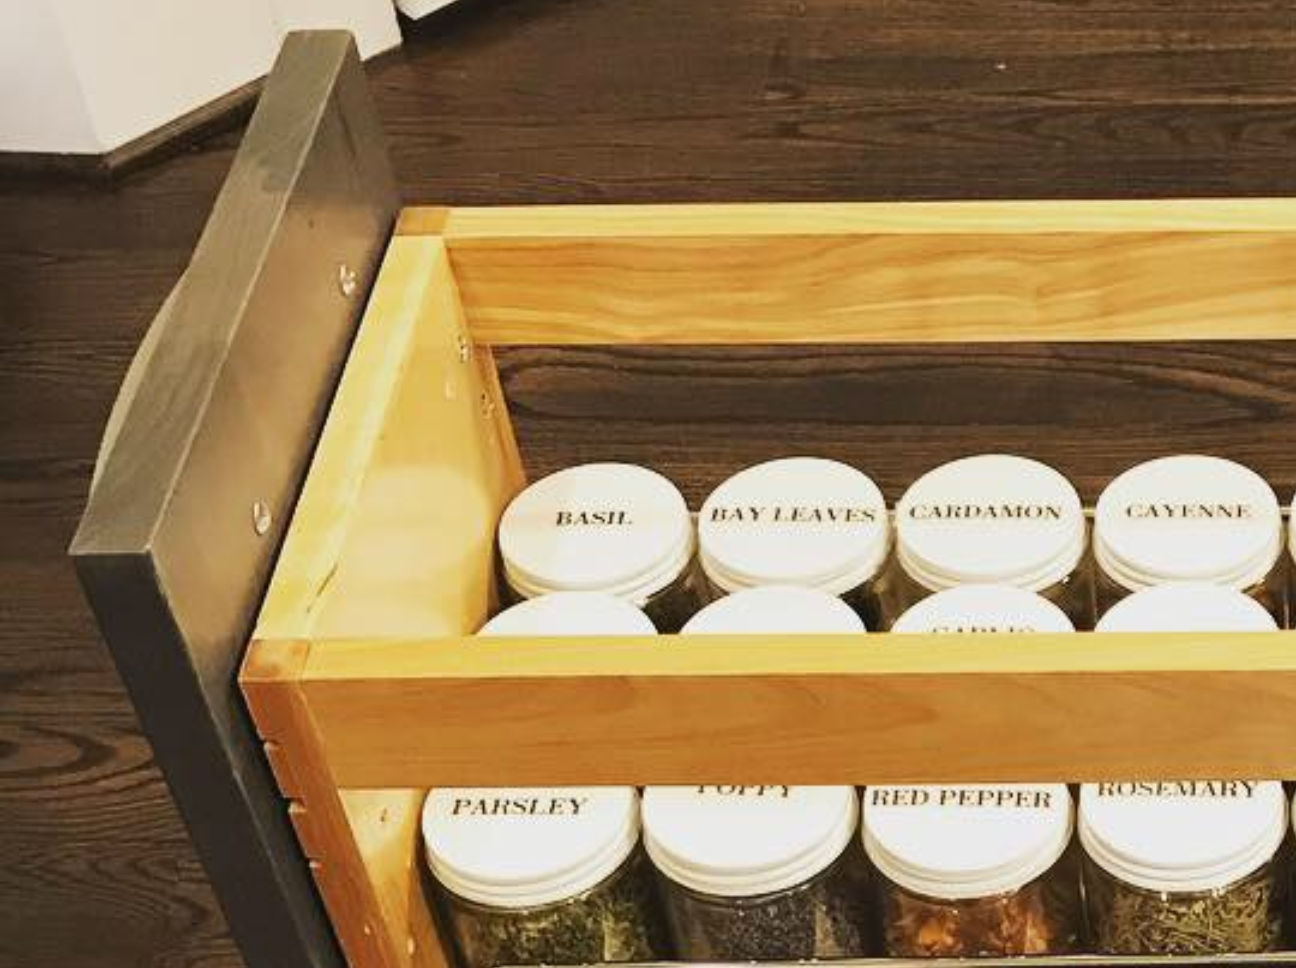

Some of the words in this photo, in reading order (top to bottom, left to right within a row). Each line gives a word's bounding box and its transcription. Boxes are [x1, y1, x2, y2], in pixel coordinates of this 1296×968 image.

[556, 510, 633, 526] BASIL
[710, 506, 766, 522] BAY
[774, 505, 876, 523] LEAVES
[909, 504, 1062, 521] CARDAMON
[1126, 502, 1254, 519] CAYENNE
[1098, 781, 1257, 798] ROSEMARY
[452, 797, 588, 816] PARSLEY
[872, 789, 929, 806] RED
[939, 789, 1053, 808] PEPPER
